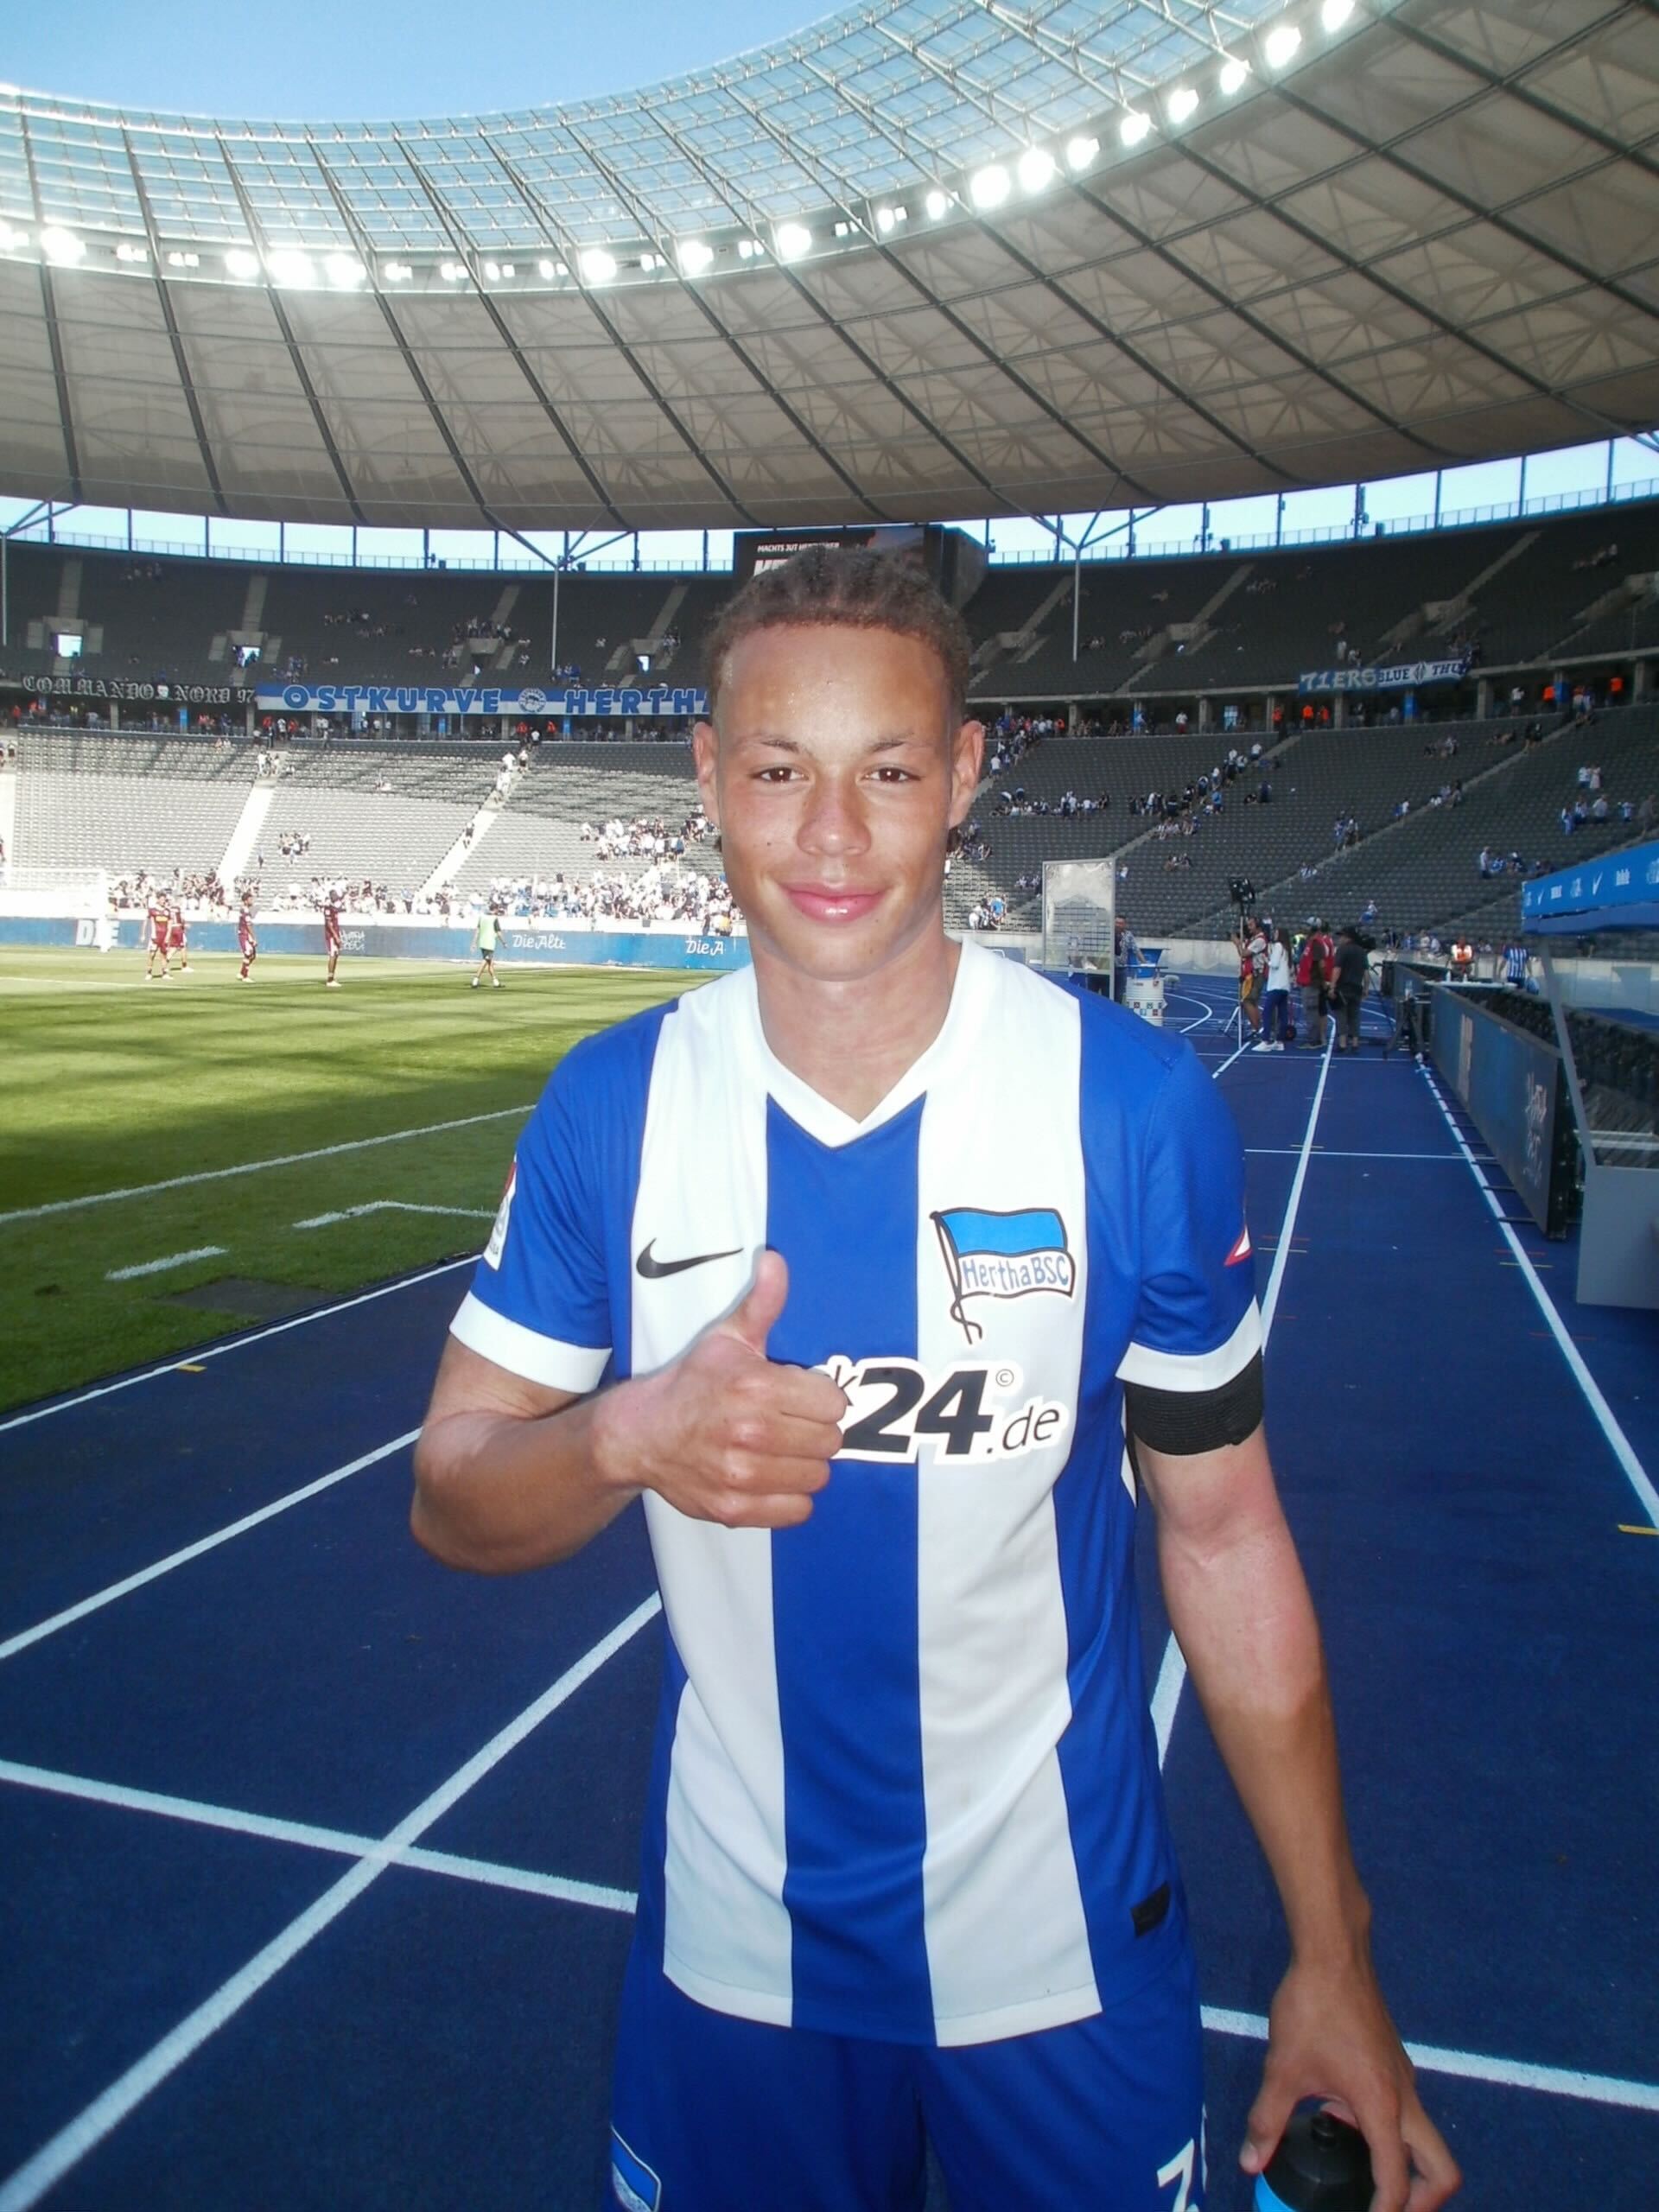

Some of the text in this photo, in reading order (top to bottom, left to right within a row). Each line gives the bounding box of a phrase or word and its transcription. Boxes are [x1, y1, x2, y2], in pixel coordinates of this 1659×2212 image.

[1378, 668, 1410, 683] BLUE
[175, 684, 231, 704] NORD
[283, 684, 501, 713] OSTKURVE
[512, 934, 535, 948] Die
[685, 939, 709, 955] Die
